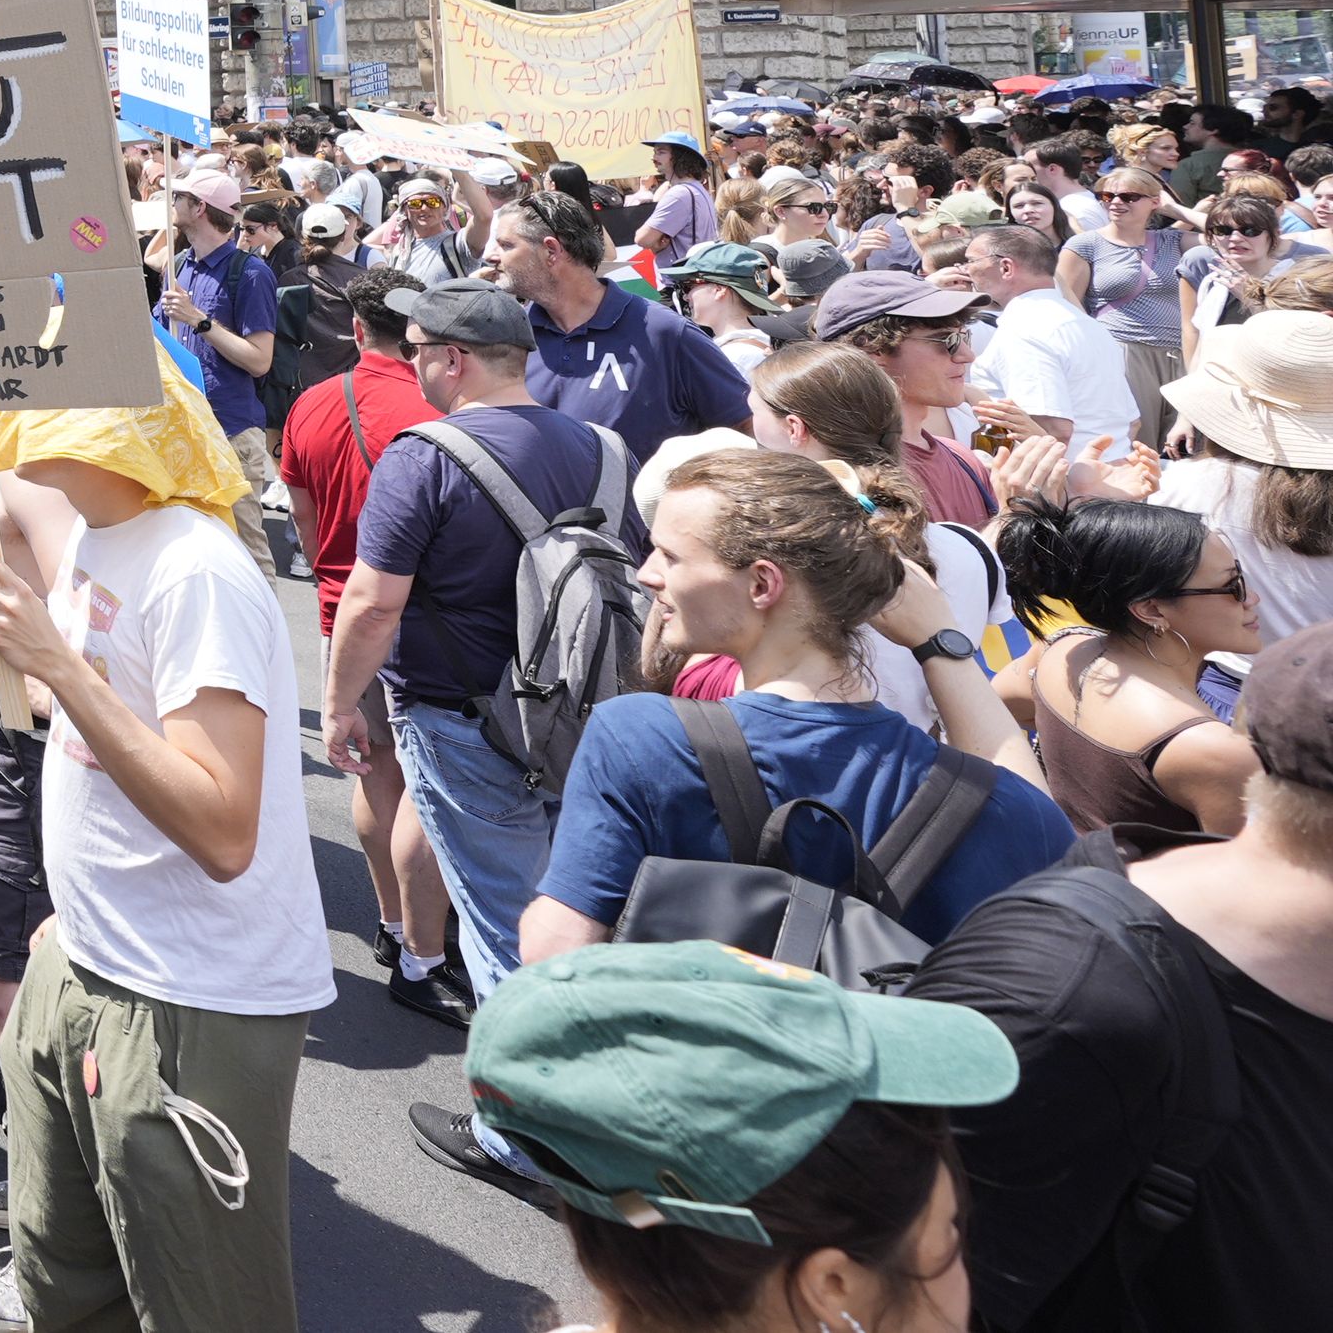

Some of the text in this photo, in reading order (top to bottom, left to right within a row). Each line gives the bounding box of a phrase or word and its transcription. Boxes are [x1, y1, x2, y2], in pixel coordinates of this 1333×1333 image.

[121, 0, 204, 35] Bildungspolitik
[122, 30, 205, 70] für schlechtere
[141, 67, 185, 98] Schulen
[75, 222, 102, 246] Mut
